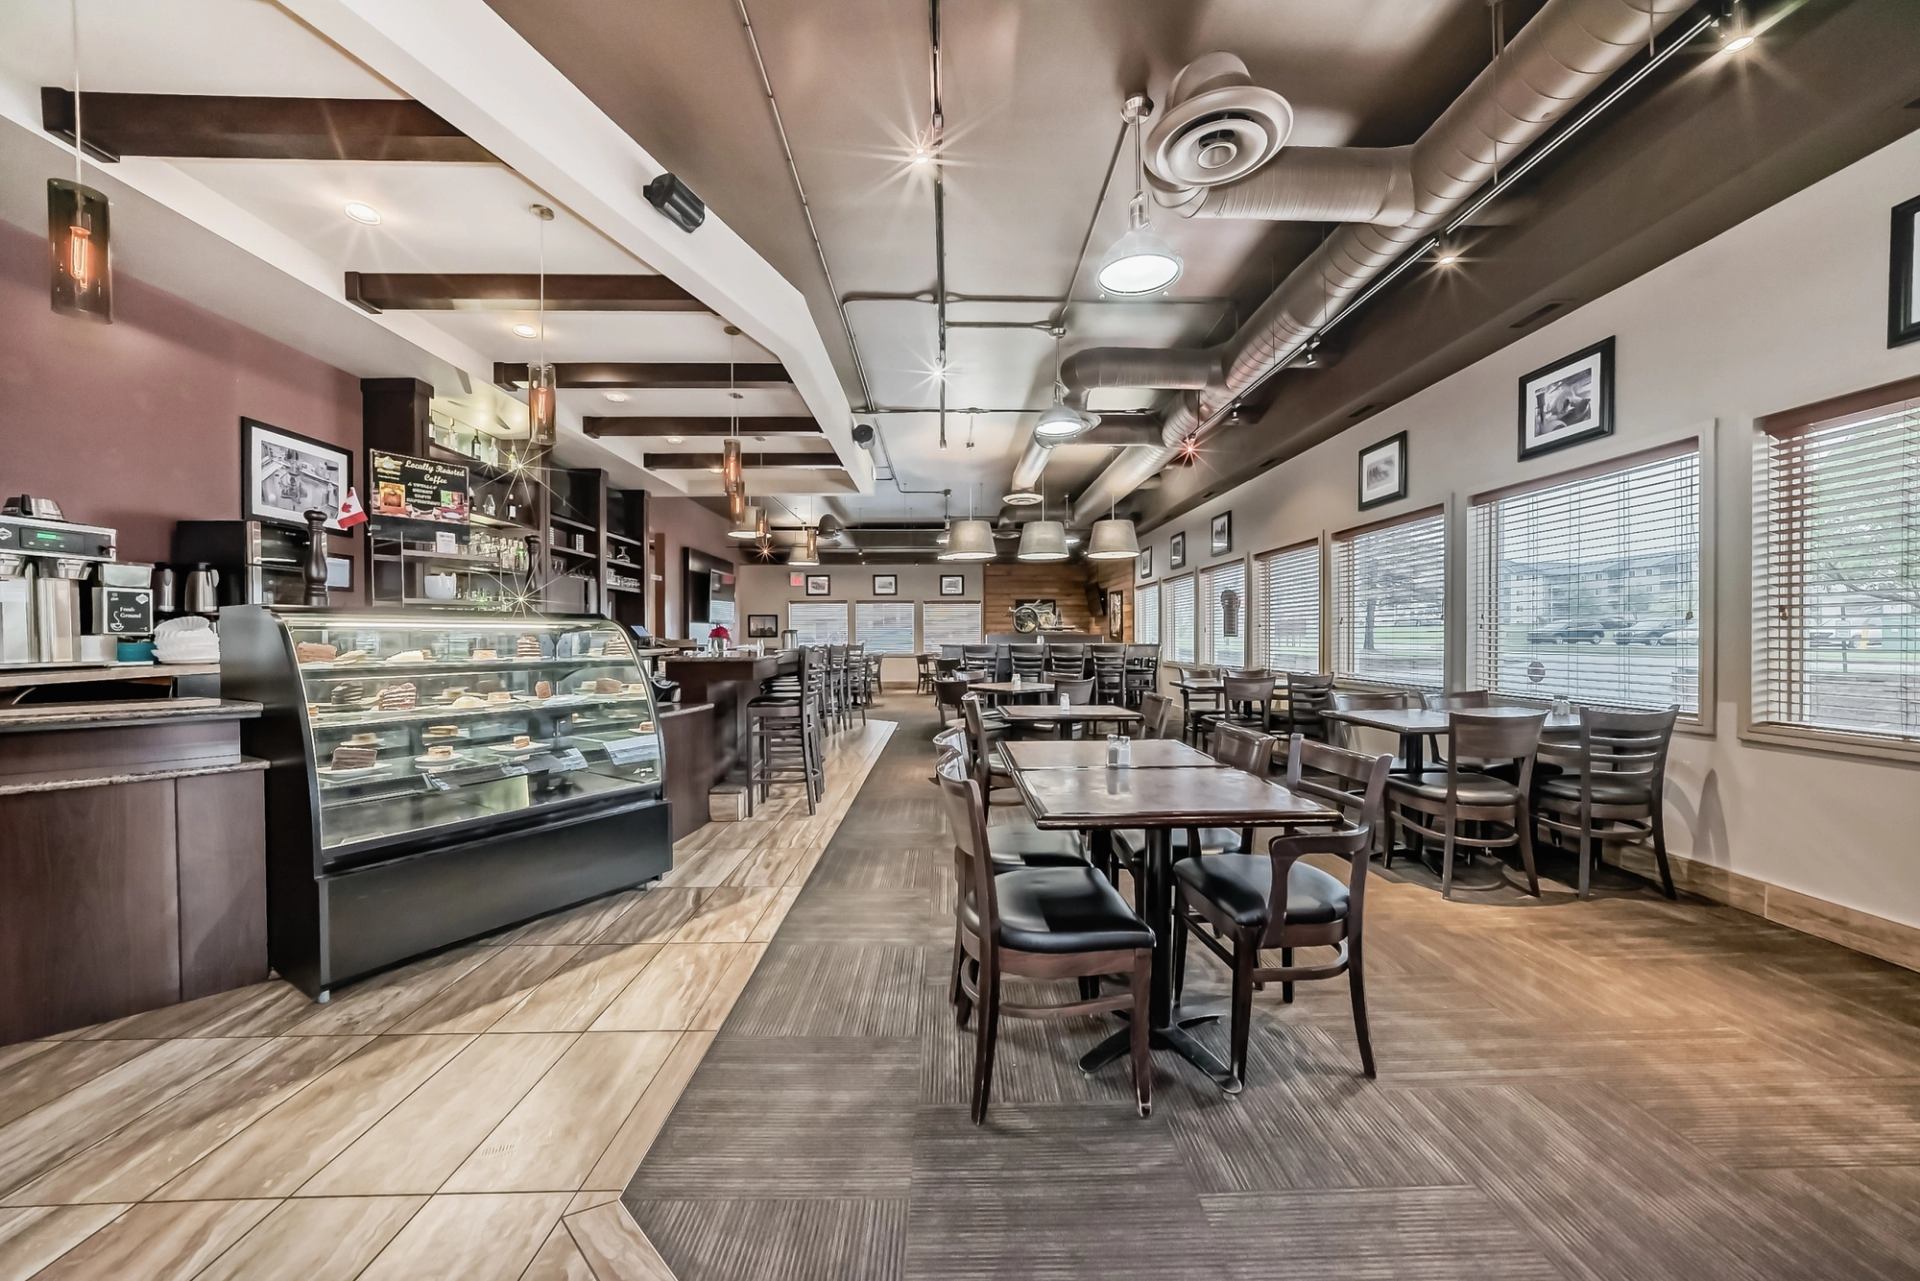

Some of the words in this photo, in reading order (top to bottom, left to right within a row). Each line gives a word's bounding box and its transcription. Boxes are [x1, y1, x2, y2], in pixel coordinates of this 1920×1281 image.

[405, 460, 434, 474] Locally
[436, 465, 464, 476] Roasted
[424, 474, 448, 484] Coffee
